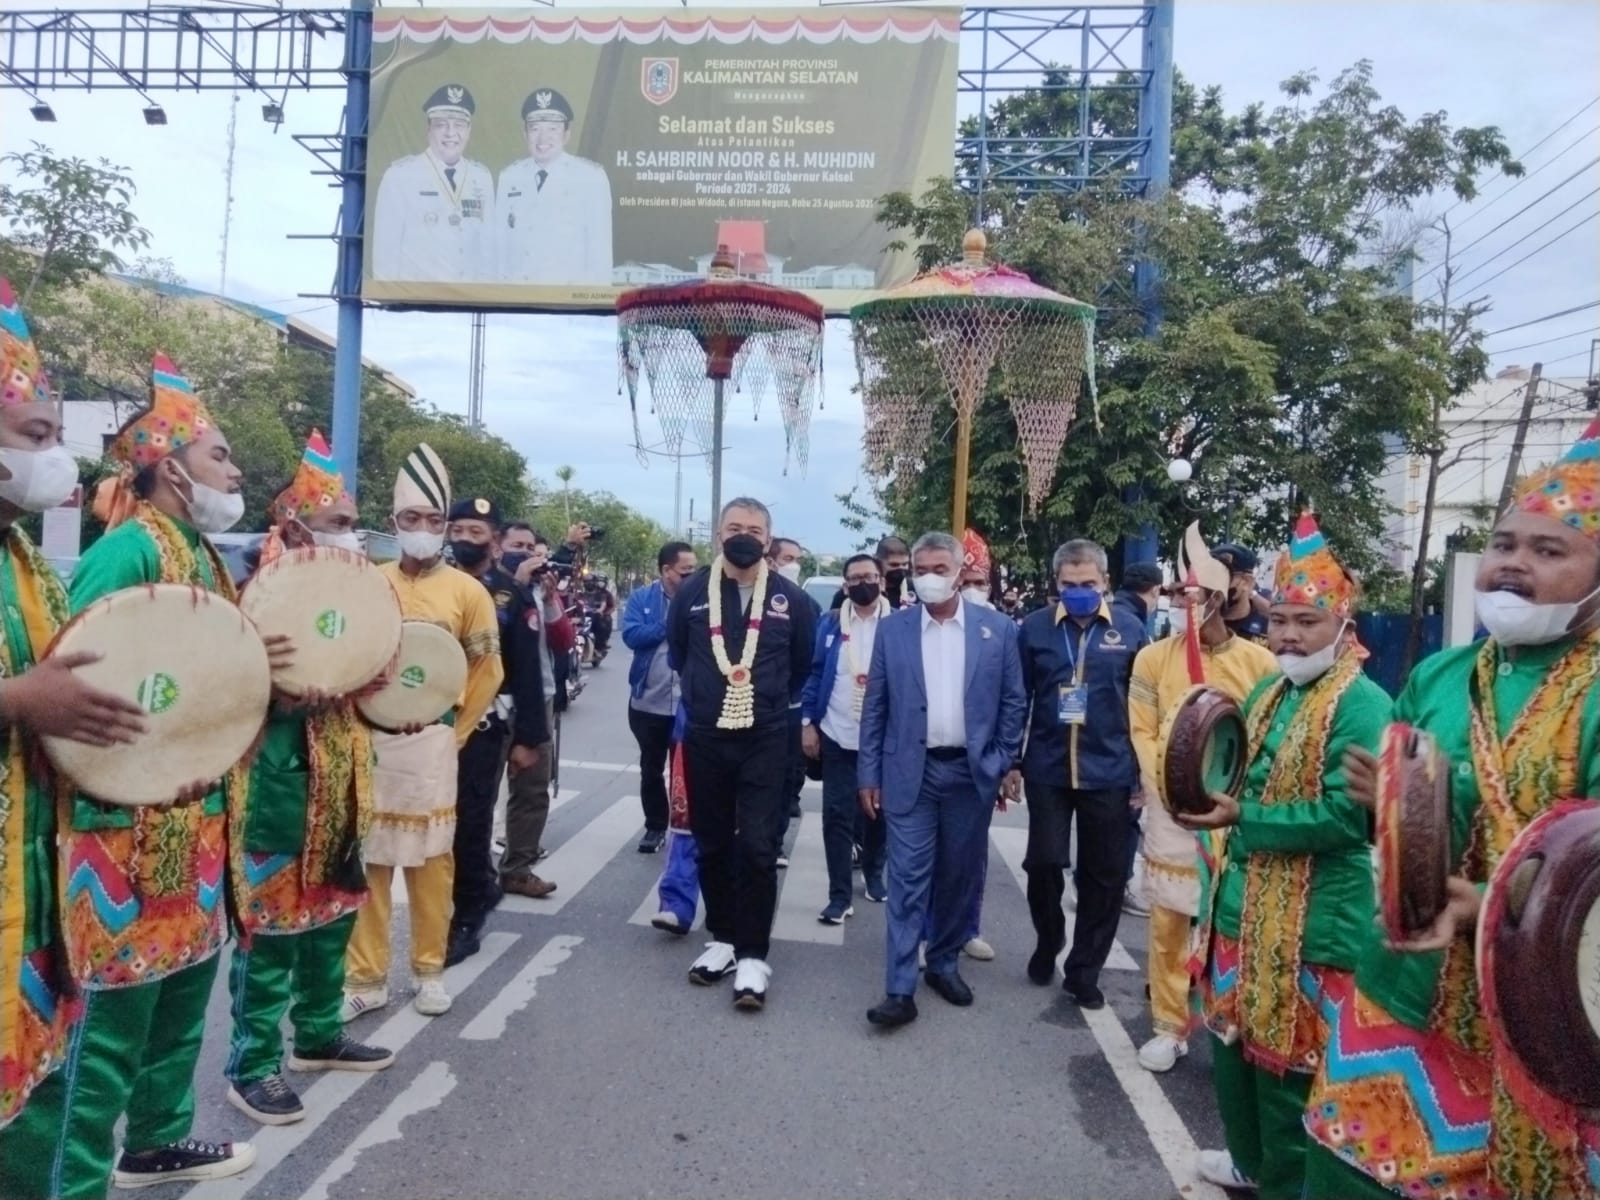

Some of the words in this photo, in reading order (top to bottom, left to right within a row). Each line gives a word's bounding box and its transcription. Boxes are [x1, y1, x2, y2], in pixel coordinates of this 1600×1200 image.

[705, 60, 780, 69] PEMERINTAH
[782, 60, 838, 69] PROVINSI
[684, 72, 785, 84] KALIMANTAN
[789, 72, 858, 84] SELATAN
[658, 115, 733, 134] Selamat
[736, 115, 767, 134] dan
[772, 115, 835, 134] Sukses
[697, 137, 724, 147] Atas
[729, 137, 795, 147] Pelantikan
[617, 151, 632, 167] H.
[636, 151, 714, 168] SAHBIRIN
[718, 151, 764, 168] NOOR
[769, 152, 780, 168] &
[784, 152, 800, 168] H.
[804, 152, 875, 169] MUHIDIN
[636, 170, 676, 183] sebagai
[677, 171, 722, 182] Gubernur
[724, 171, 743, 182] dan
[745, 171, 771, 182] Wakil
[773, 171, 819, 182] Gubernur
[822, 172, 853, 183] Kalsel
[696, 183, 732, 194] Periode
[734, 184, 757, 194] 2021
[766, 184, 791, 194] 2024
[638, 197, 671, 206] Presiden
[823, 199, 854, 209] Agustus
